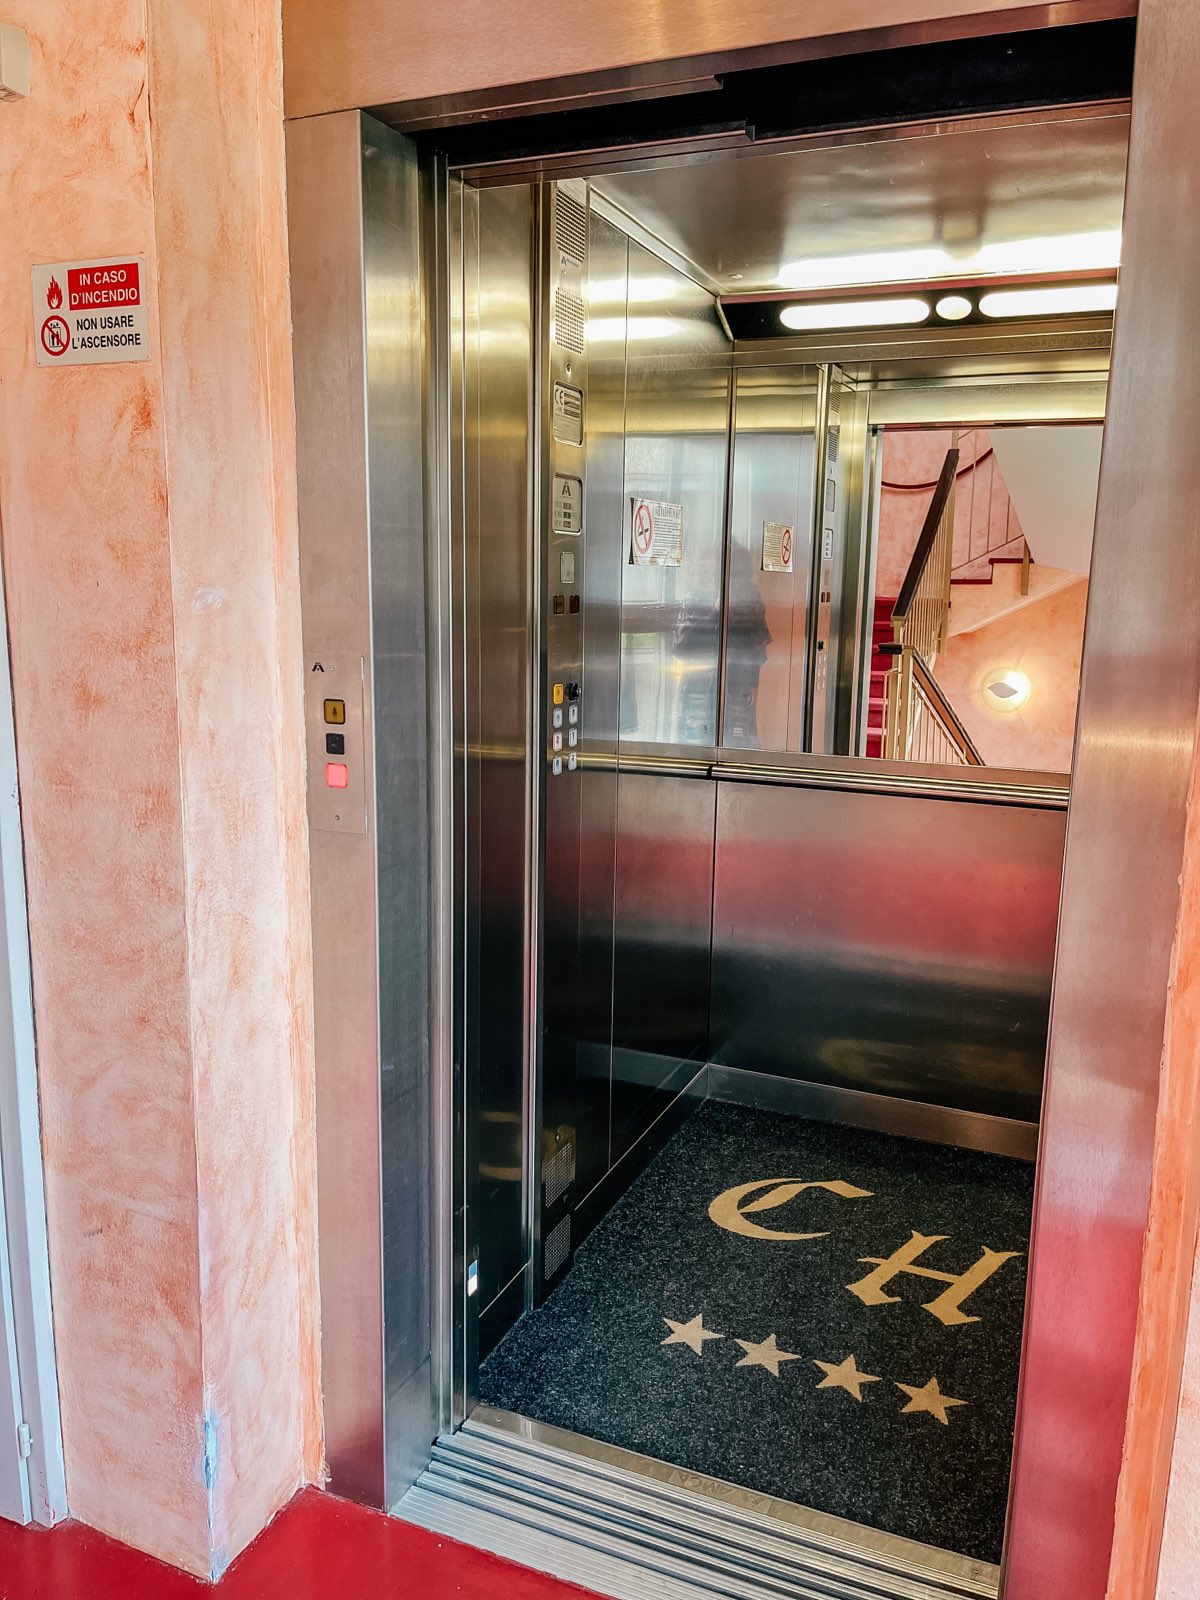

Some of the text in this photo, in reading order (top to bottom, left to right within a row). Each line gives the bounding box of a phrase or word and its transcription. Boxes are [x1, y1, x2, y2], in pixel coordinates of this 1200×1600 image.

[80, 270, 127, 286] IN CASO
[71, 288, 138, 305] D'INCENDIO
[76, 315, 134, 331] NON USARE
[72, 333, 141, 349] L'ASCENSORE
[708, 1178, 1024, 1326] C H
